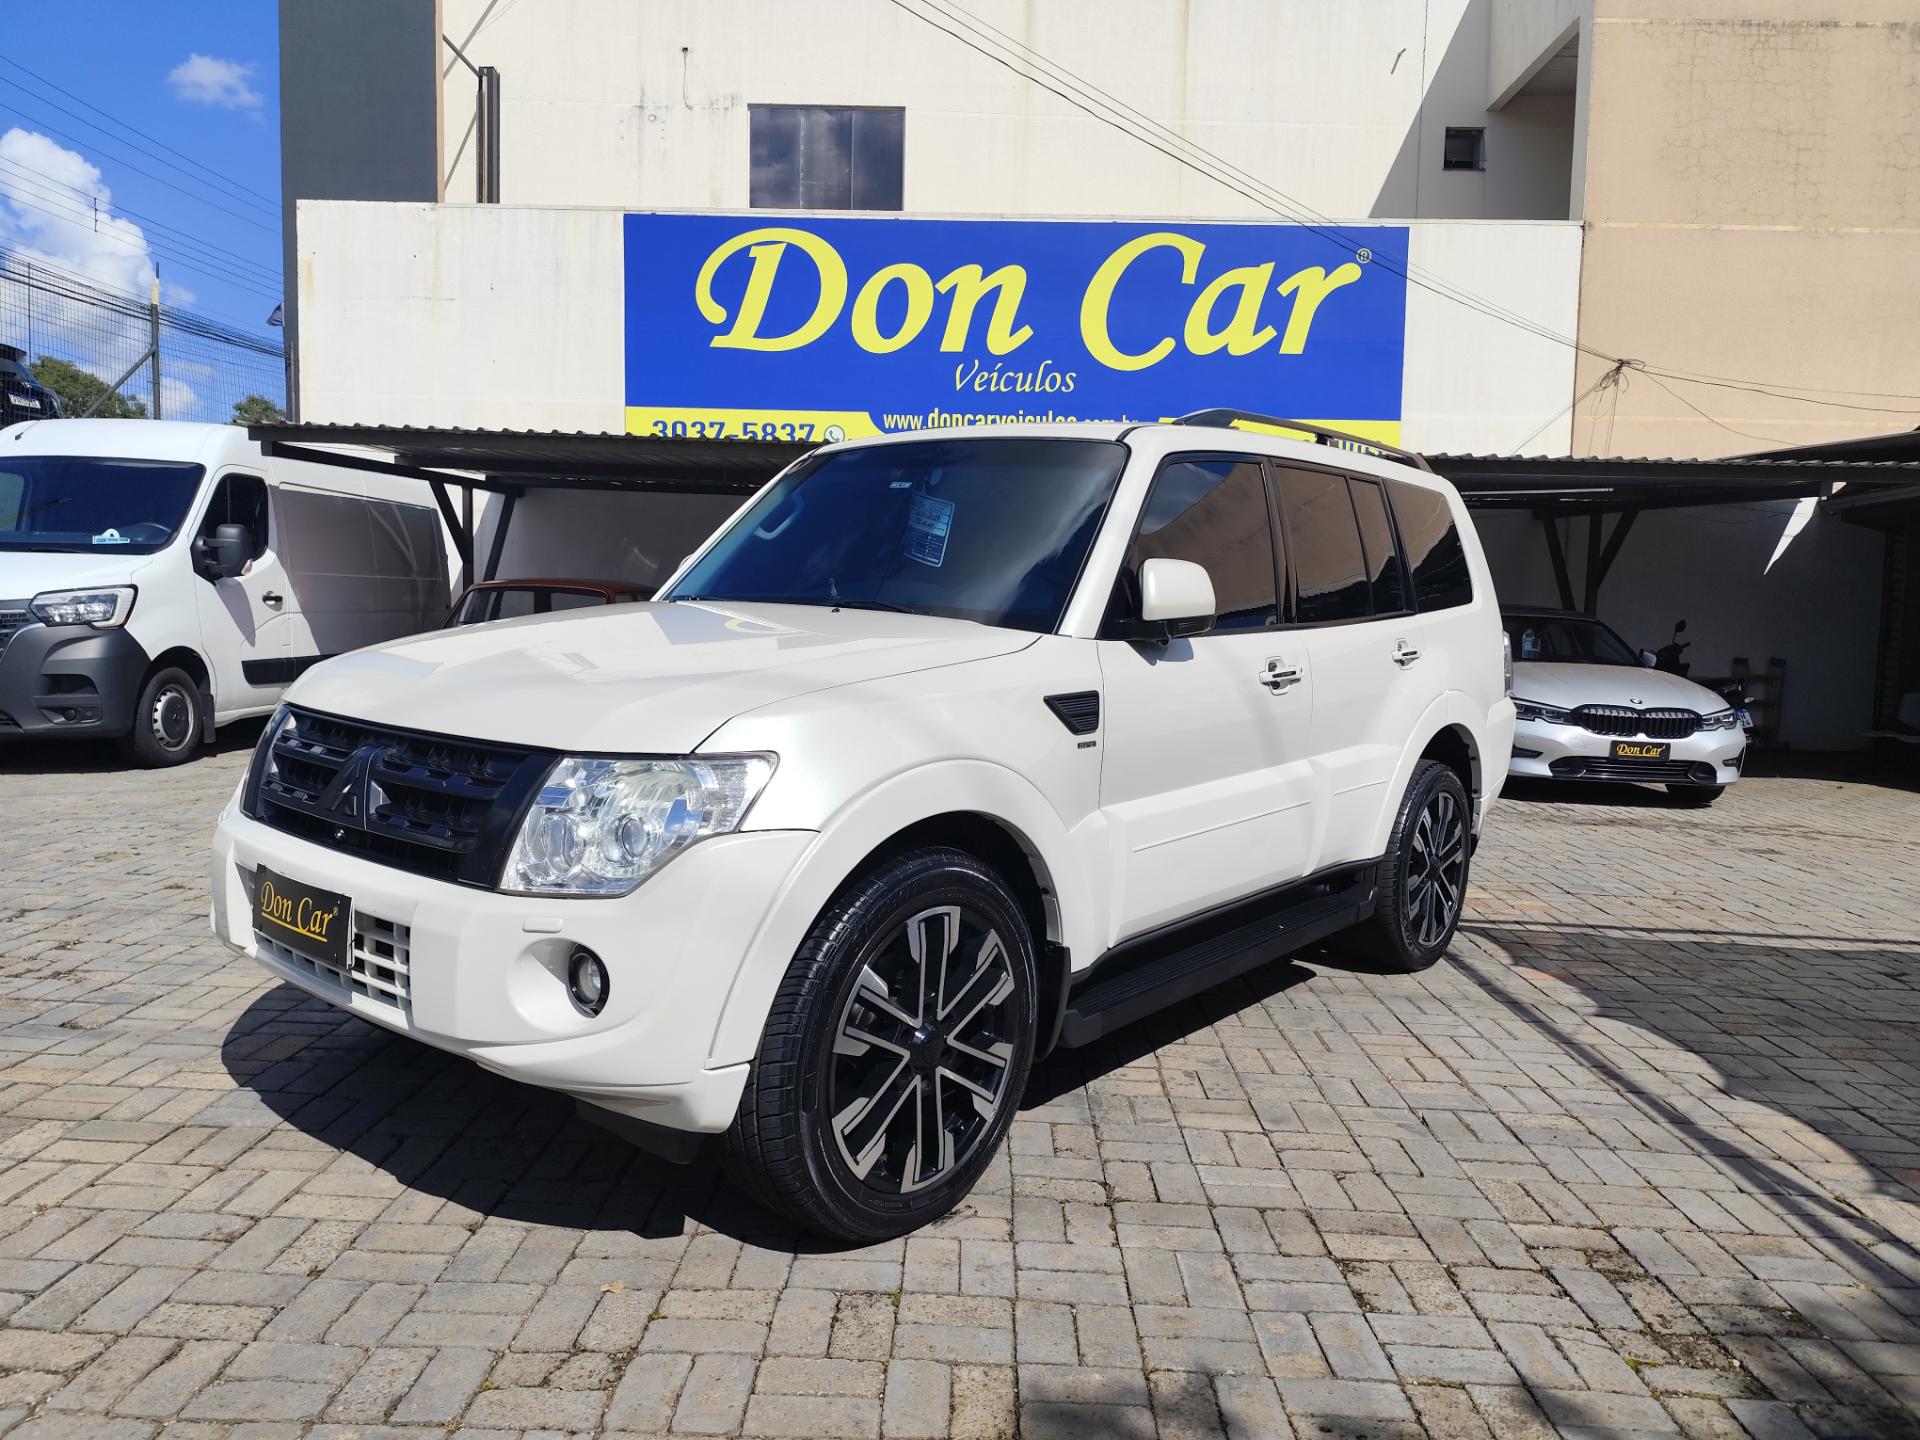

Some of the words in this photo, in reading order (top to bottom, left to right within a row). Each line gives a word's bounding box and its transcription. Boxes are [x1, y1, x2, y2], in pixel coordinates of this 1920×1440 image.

[695, 227, 1034, 355] Don
[955, 359, 1077, 393] Veículos
[652, 420, 816, 442] 3037-5837
[1617, 743, 1640, 755] Don
[261, 881, 293, 922] Don
